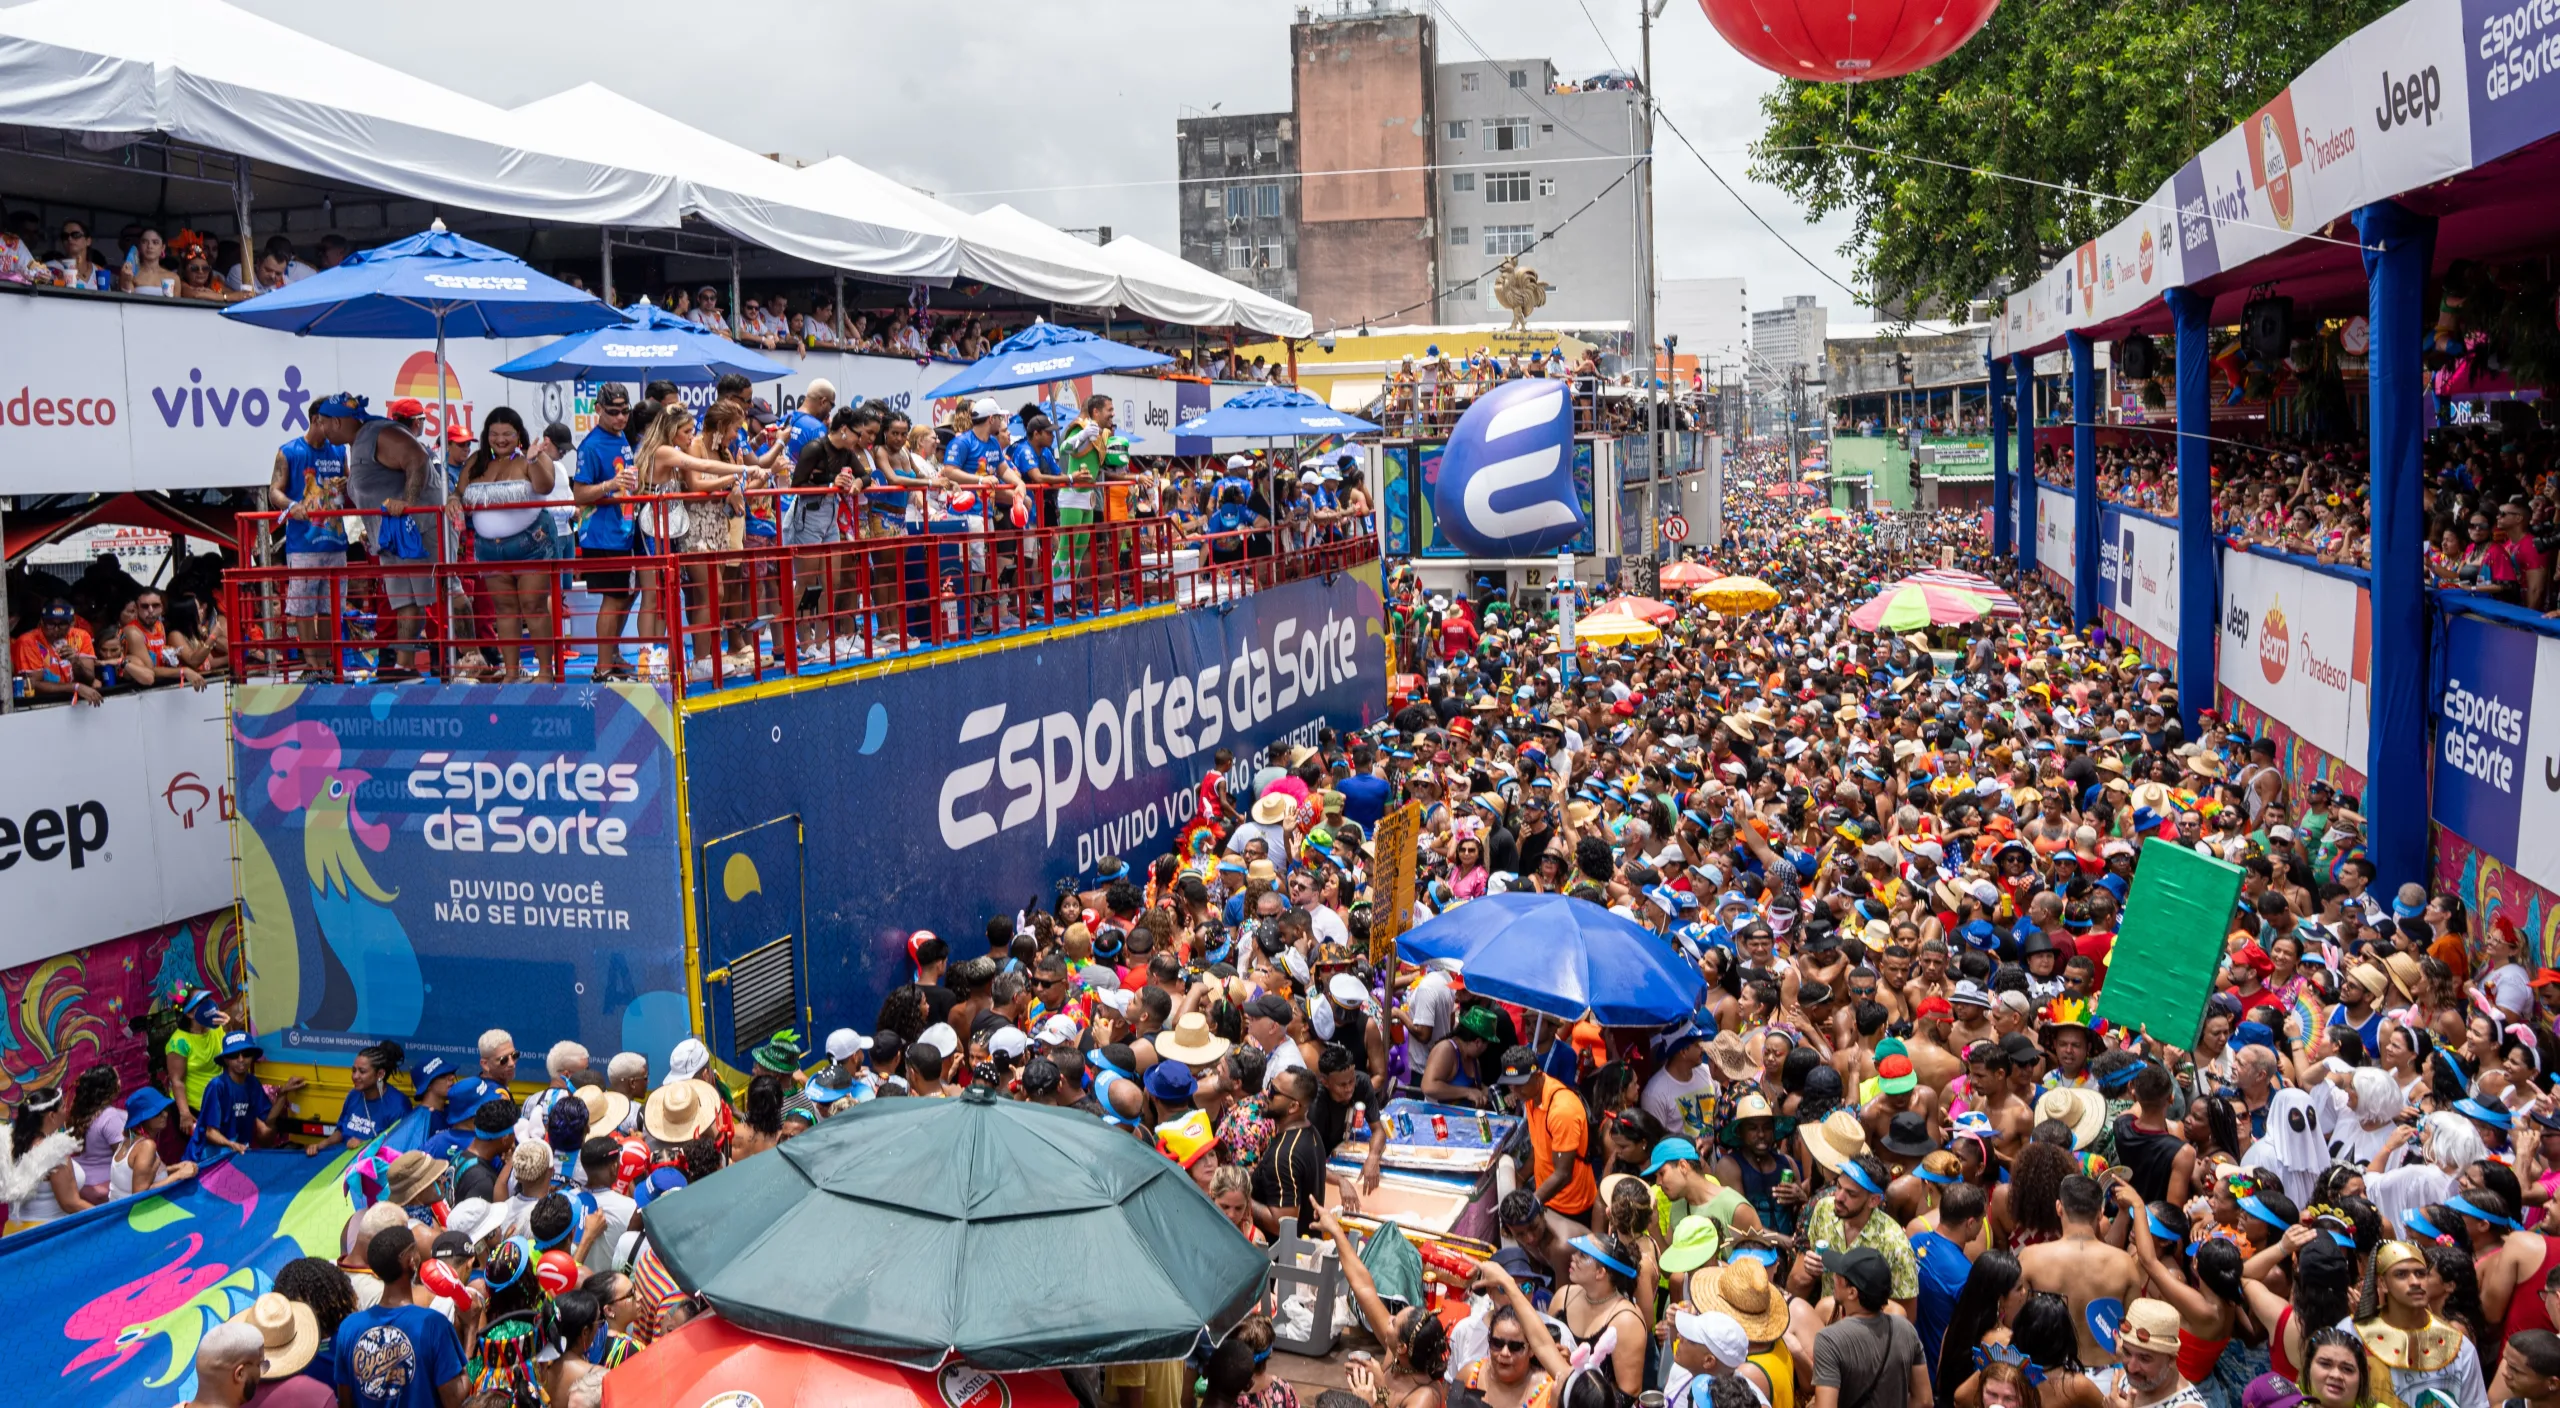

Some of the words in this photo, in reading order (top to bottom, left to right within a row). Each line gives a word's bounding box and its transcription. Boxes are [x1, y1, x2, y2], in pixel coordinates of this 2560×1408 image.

[2376, 65, 2441, 132] Jeep
[2267, 153, 2284, 177] AMSTEL
[2316, 126, 2355, 169] bradesco
[2213, 185, 2237, 228] vivo
[0, 386, 116, 427] desco
[152, 367, 270, 428] vivo
[1145, 400, 1169, 432] Jeep
[1526, 569, 1541, 586] E2
[2227, 593, 2250, 649] Jeep
[2260, 626, 2287, 667] Seara
[2310, 651, 2347, 692] bradesco
[2443, 678, 2523, 746] Esportes
[938, 662, 1224, 850] Esportes
[408, 752, 639, 812] Esportes
[0, 800, 109, 871] eep
[1077, 802, 1158, 874] DUVIDO
[1163, 782, 1201, 829] VOC
[449, 879, 535, 901] DUVIDO
[541, 881, 604, 905] VOCÊ
[434, 898, 481, 923] NÃO
[488, 904, 516, 925] SE
[523, 906, 630, 931] DIVERTIR
[335, 1038, 381, 1048] RESPONSABILI
[955, 1373, 988, 1403] AMSTEL
[970, 1388, 989, 1406] LAGER
